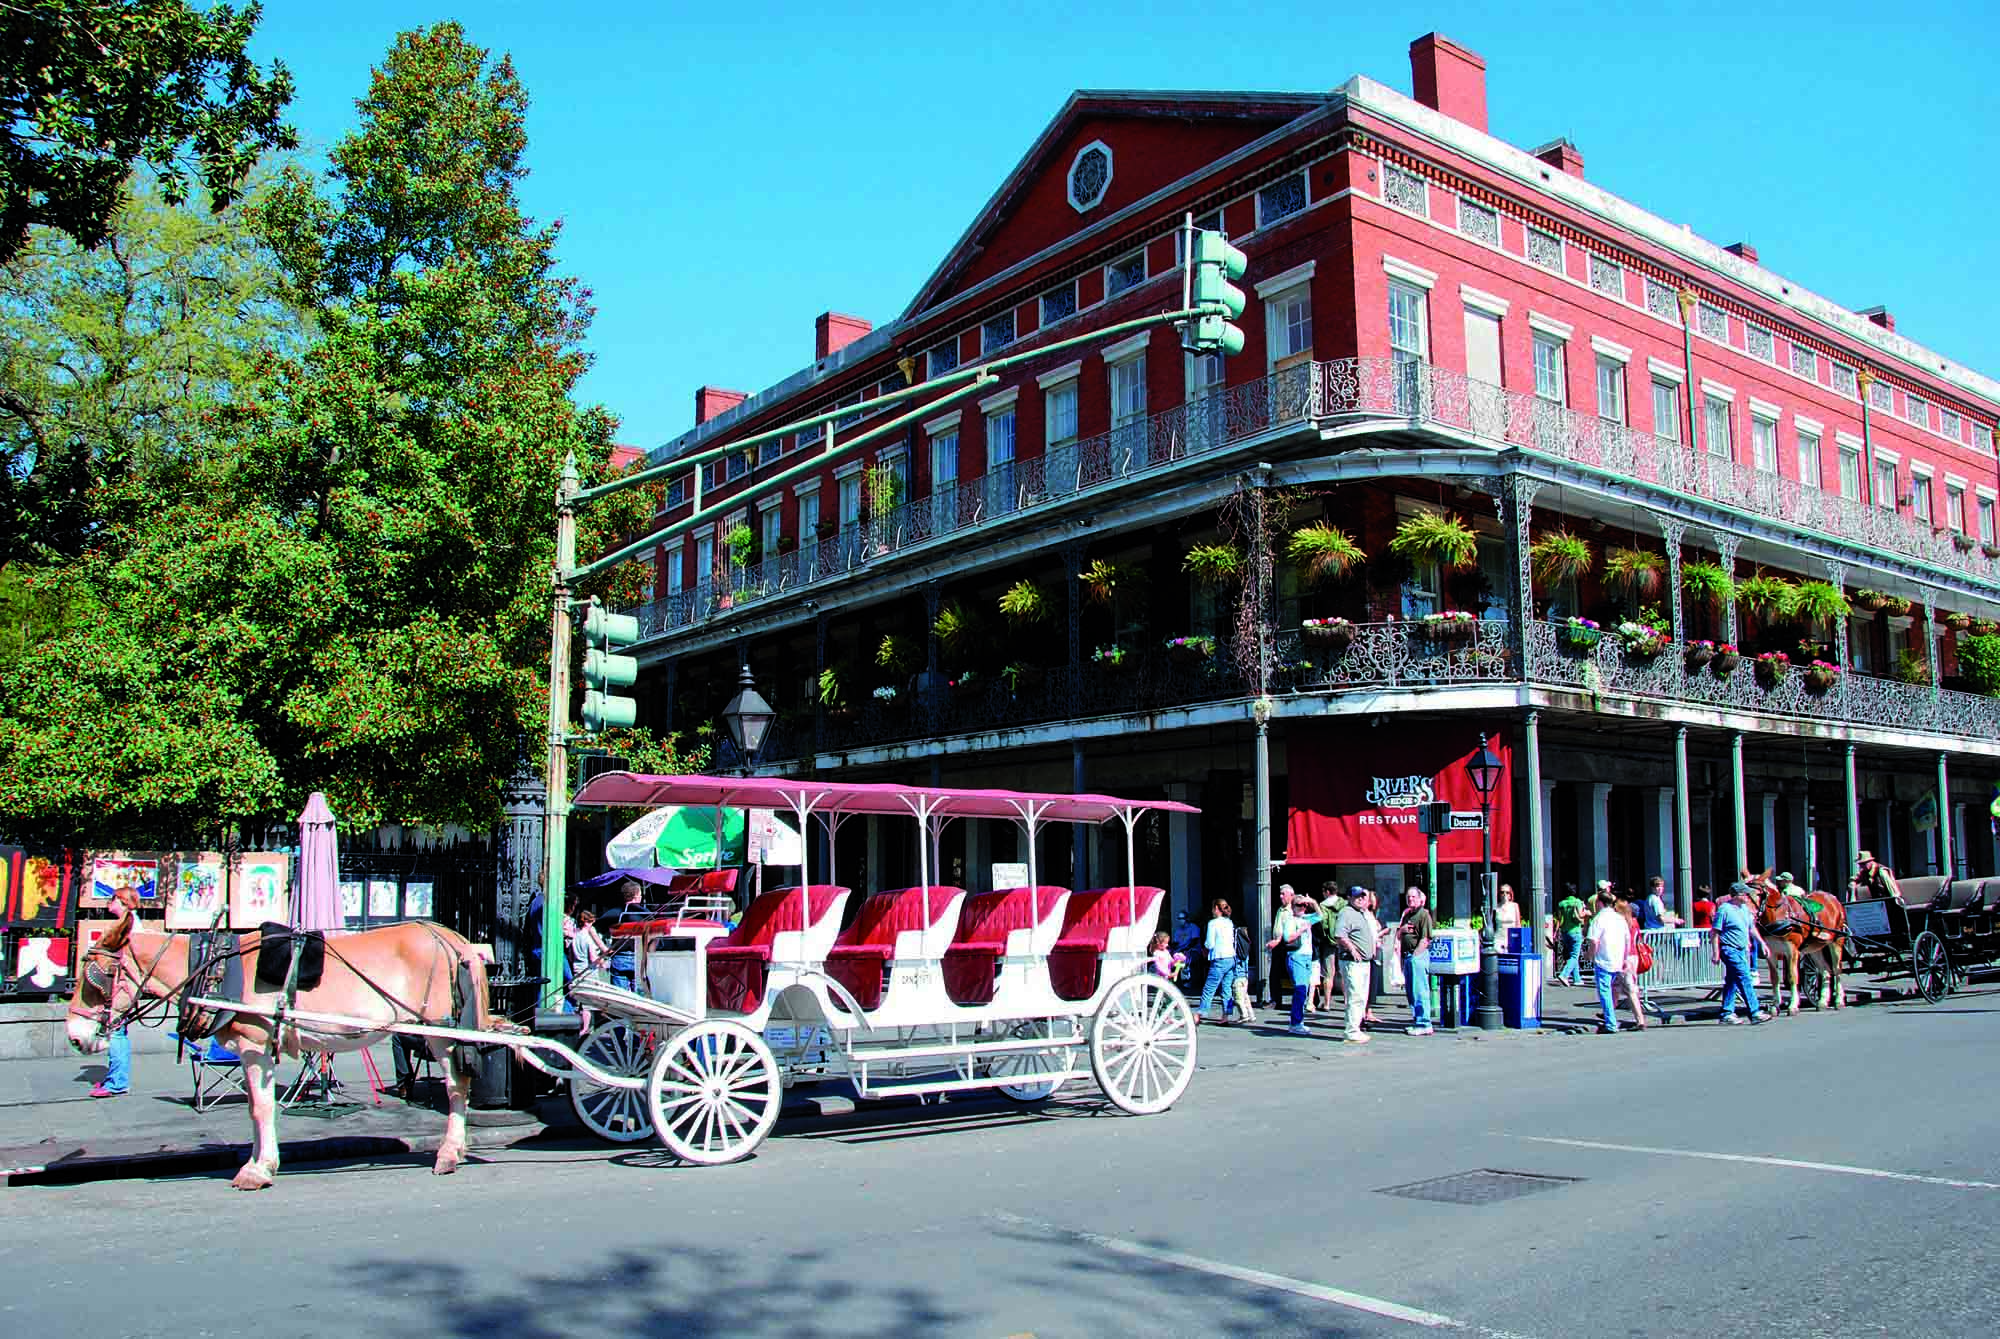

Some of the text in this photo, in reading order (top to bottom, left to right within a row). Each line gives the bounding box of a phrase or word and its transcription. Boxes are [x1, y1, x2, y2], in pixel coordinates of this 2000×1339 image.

[1366, 775, 1434, 806] RIVER'S
[1359, 815, 1417, 825] RESTAUR
[1453, 817, 1480, 827] Decatur
[1433, 943, 1450, 951] USA
